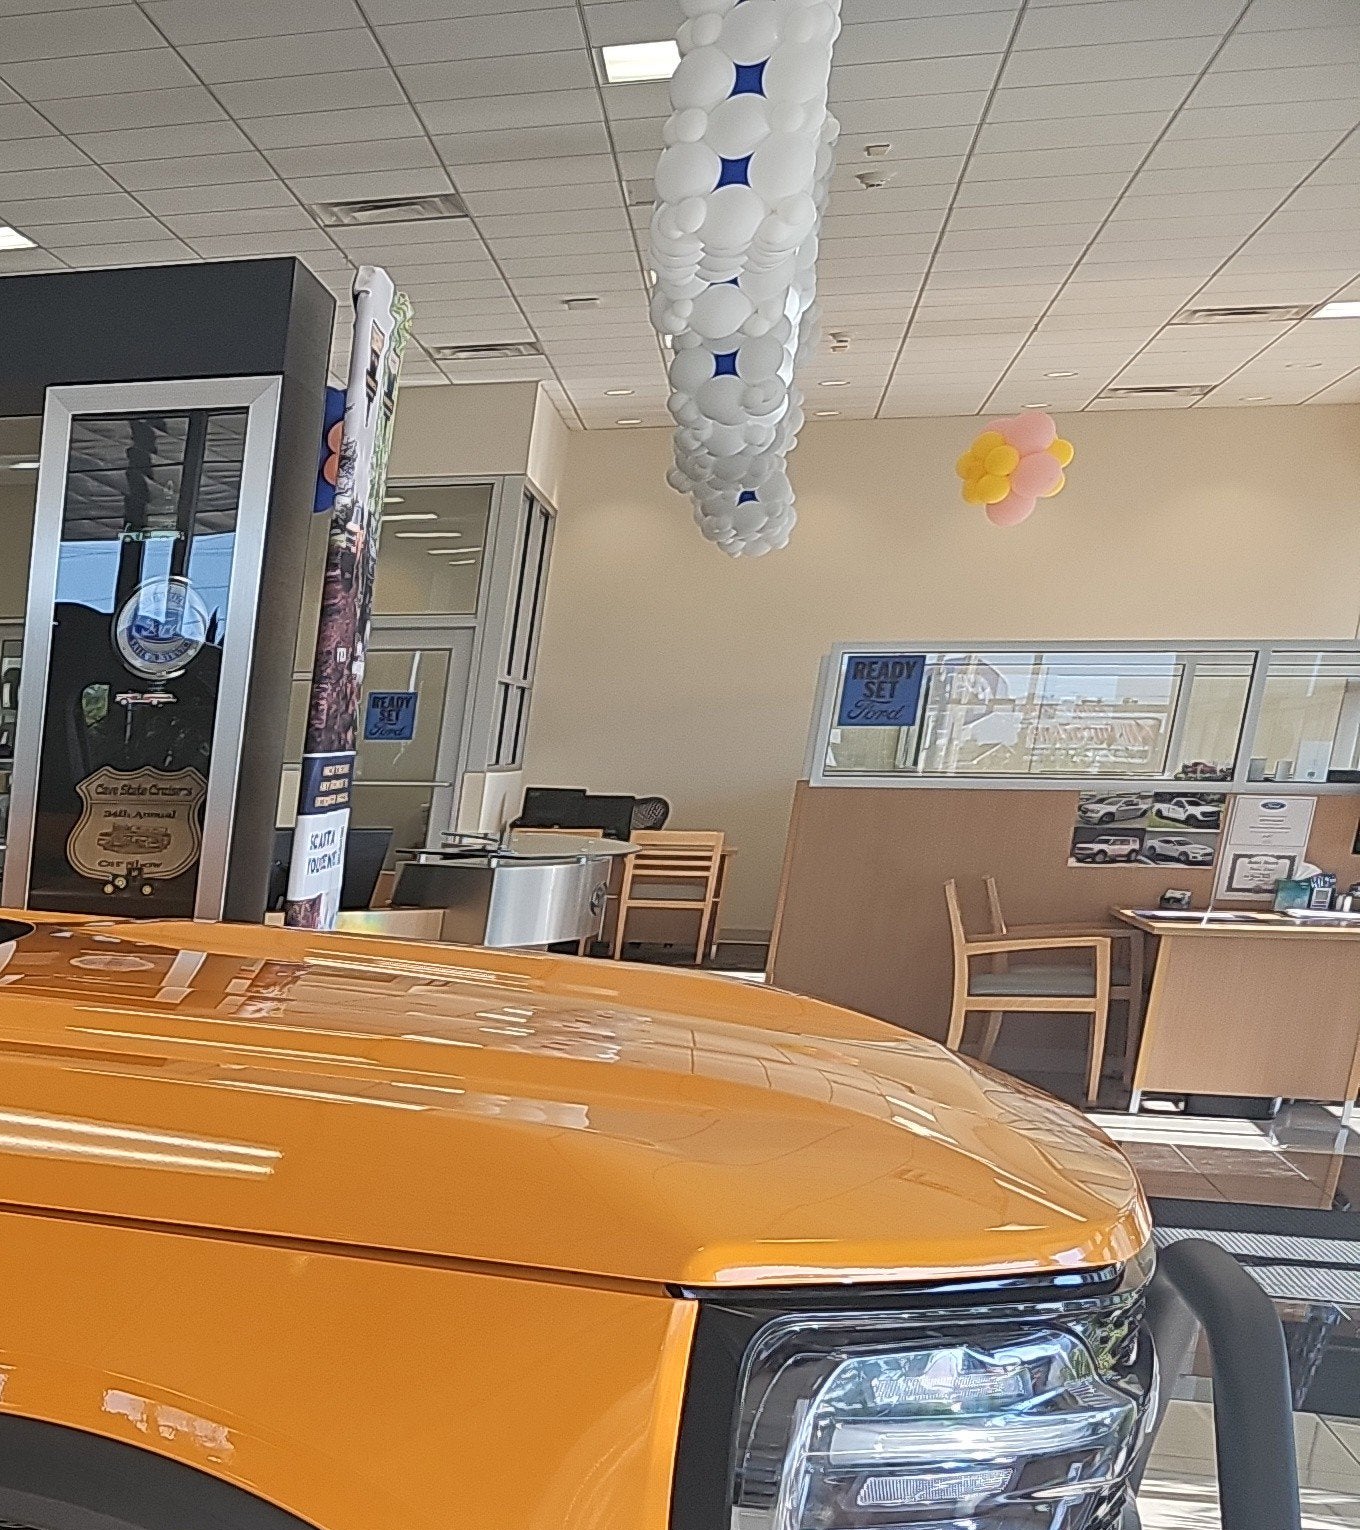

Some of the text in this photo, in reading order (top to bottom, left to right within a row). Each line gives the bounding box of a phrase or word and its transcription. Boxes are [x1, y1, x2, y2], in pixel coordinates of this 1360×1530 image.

[852, 661, 917, 680] READY
[863, 680, 899, 699] SET
[371, 695, 413, 709] READY
[379, 709, 400, 722] SET
[847, 699, 905, 720] Ford
[369, 722, 407, 736] Ford
[94, 784, 193, 797] Cave State Cruisers
[133, 810, 177, 820] Annual
[97, 860, 124, 868] Car
